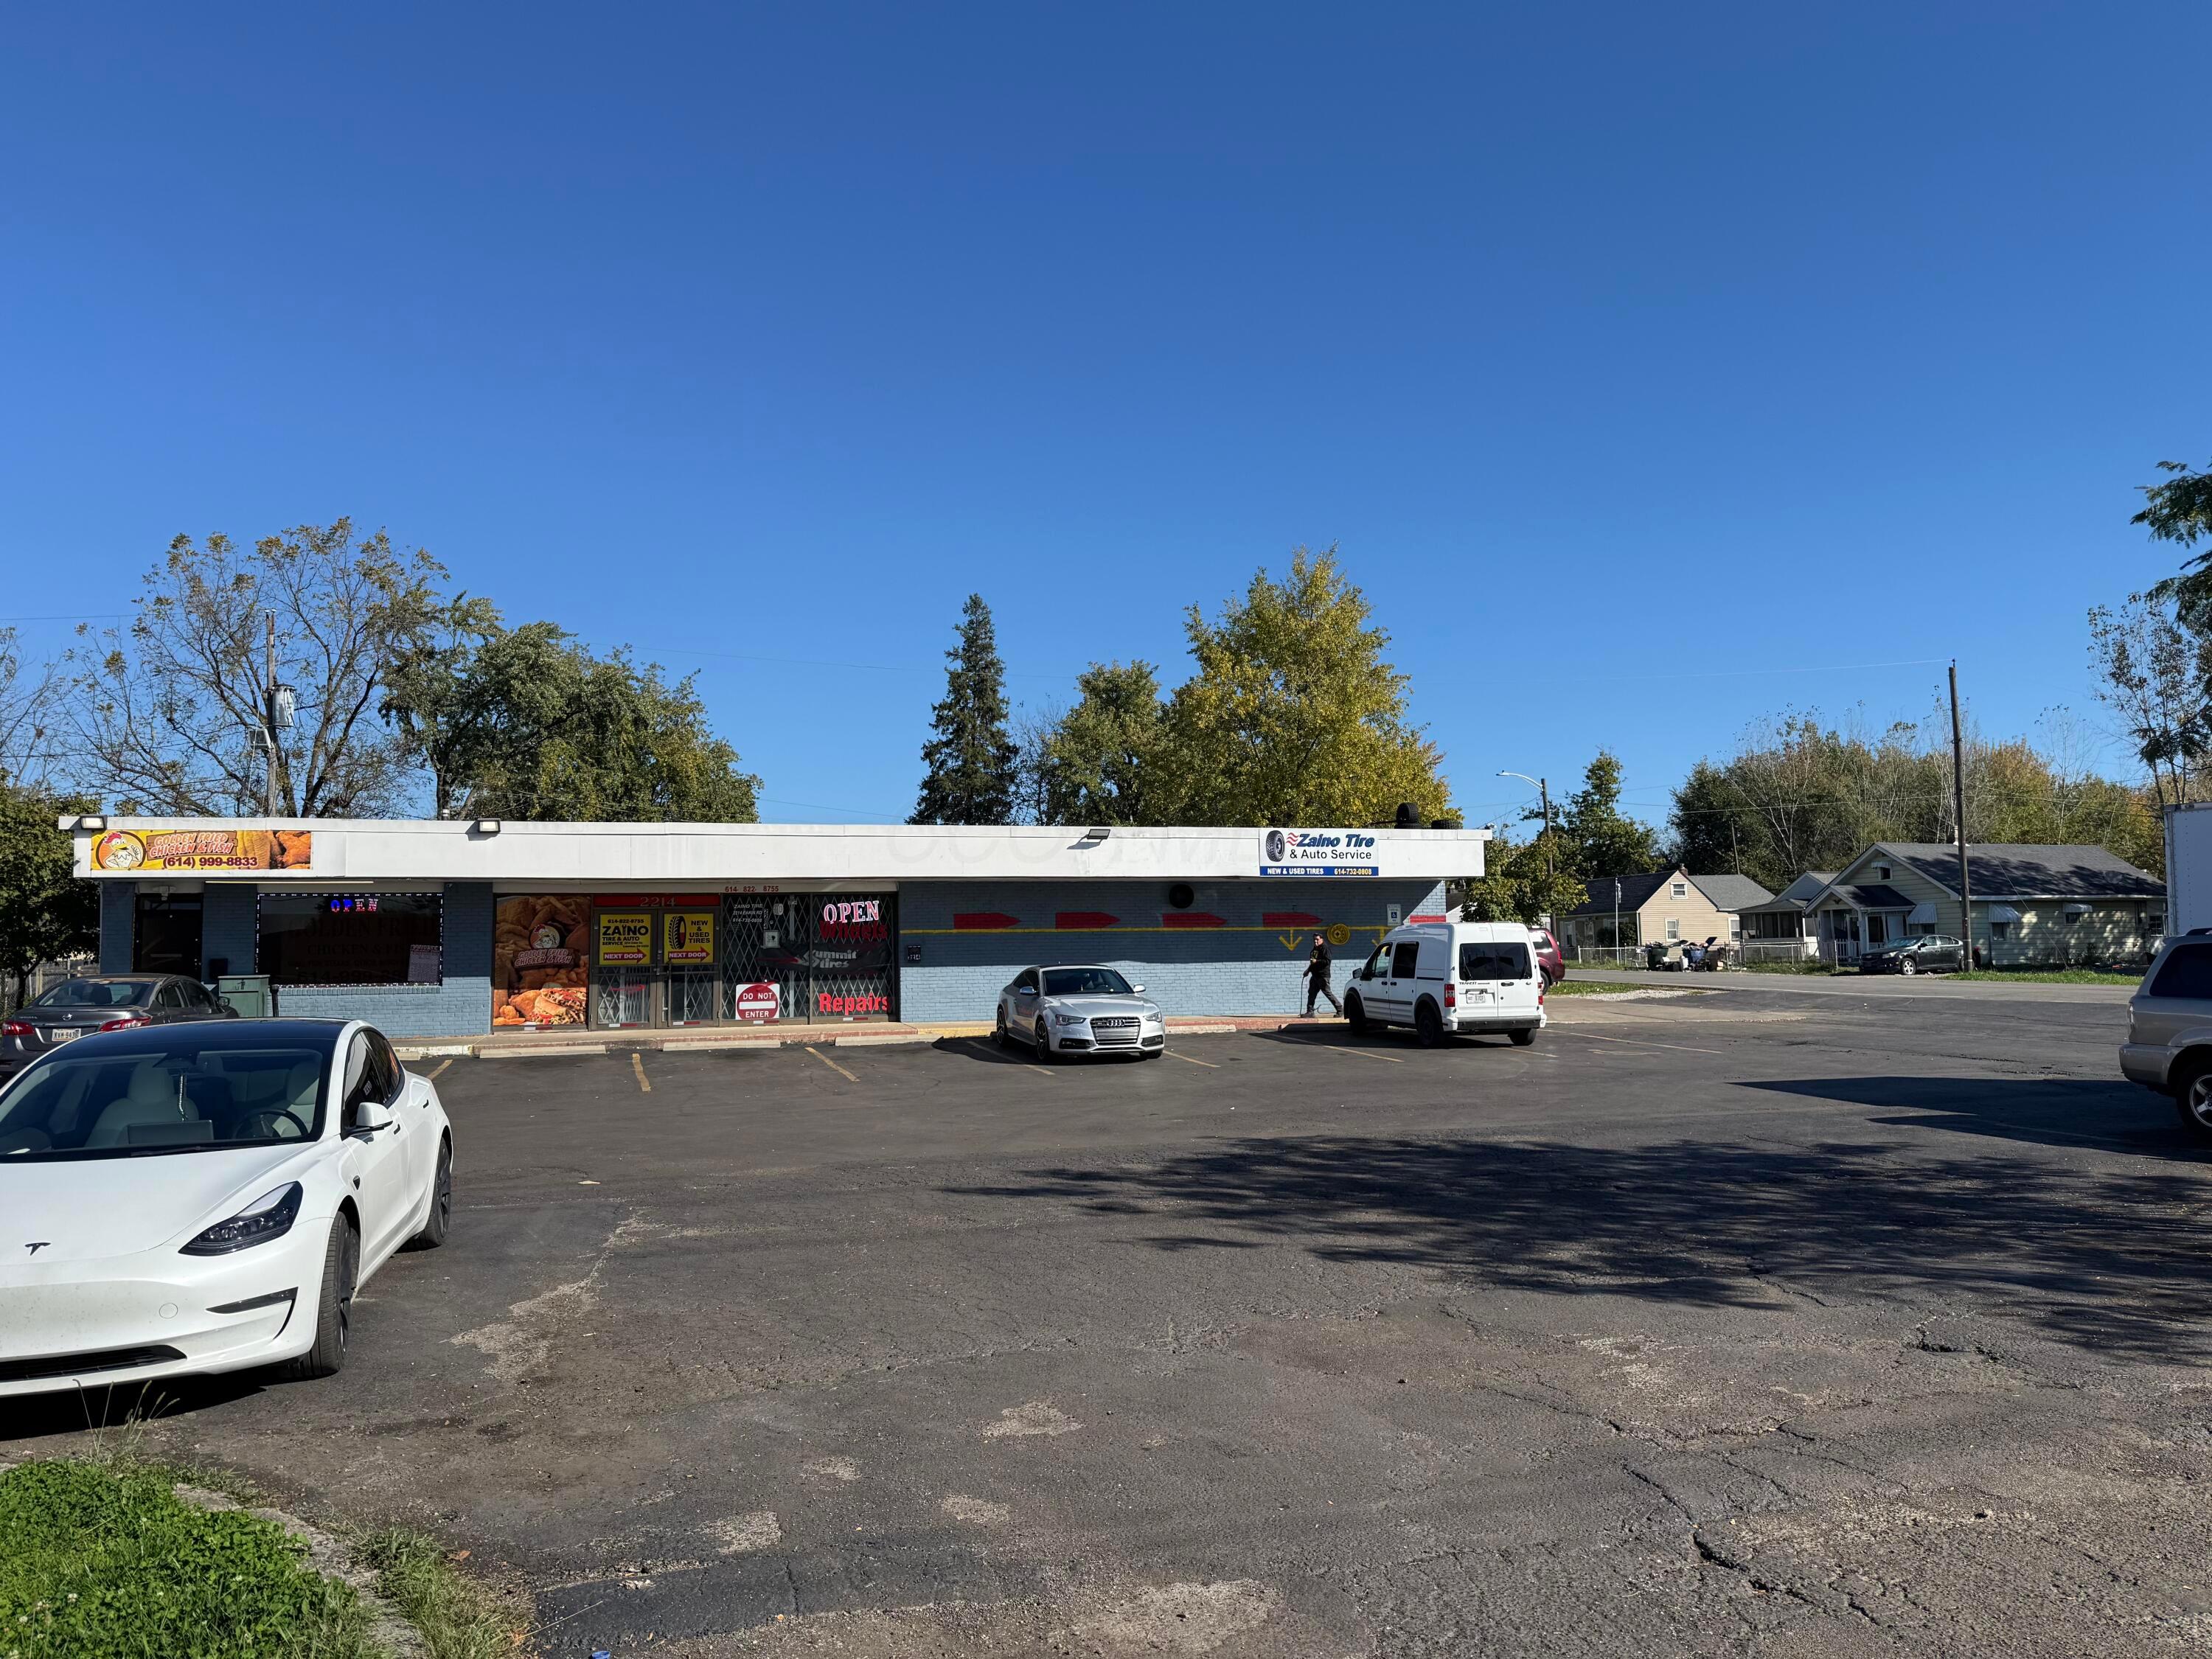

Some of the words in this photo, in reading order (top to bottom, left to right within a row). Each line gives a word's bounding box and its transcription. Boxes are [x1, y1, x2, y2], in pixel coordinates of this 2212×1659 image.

[154, 833, 197, 846] GOLDEN
[197, 832, 229, 844] FRIED
[1296, 834, 1340, 848] Zaino
[1345, 834, 1375, 848] Tire
[150, 843, 196, 858] CHICKEN
[197, 843, 207, 853] &
[209, 843, 234, 855] FISH
[1290, 849, 1297, 859] &
[1301, 849, 1327, 859] Auto
[1331, 849, 1371, 859] Service
[163, 857, 195, 869] (614)
[199, 857, 258, 866] 999-8833
[331, 899, 378, 913] OPEN
[640, 897, 676, 907] 2214
[824, 900, 880, 924] OPEN
[518, 949, 547, 958] GOLDEN
[515, 956, 547, 967] CHICKEN
[820, 958, 849, 968] tires
[818, 992, 889, 1015] Repairs
